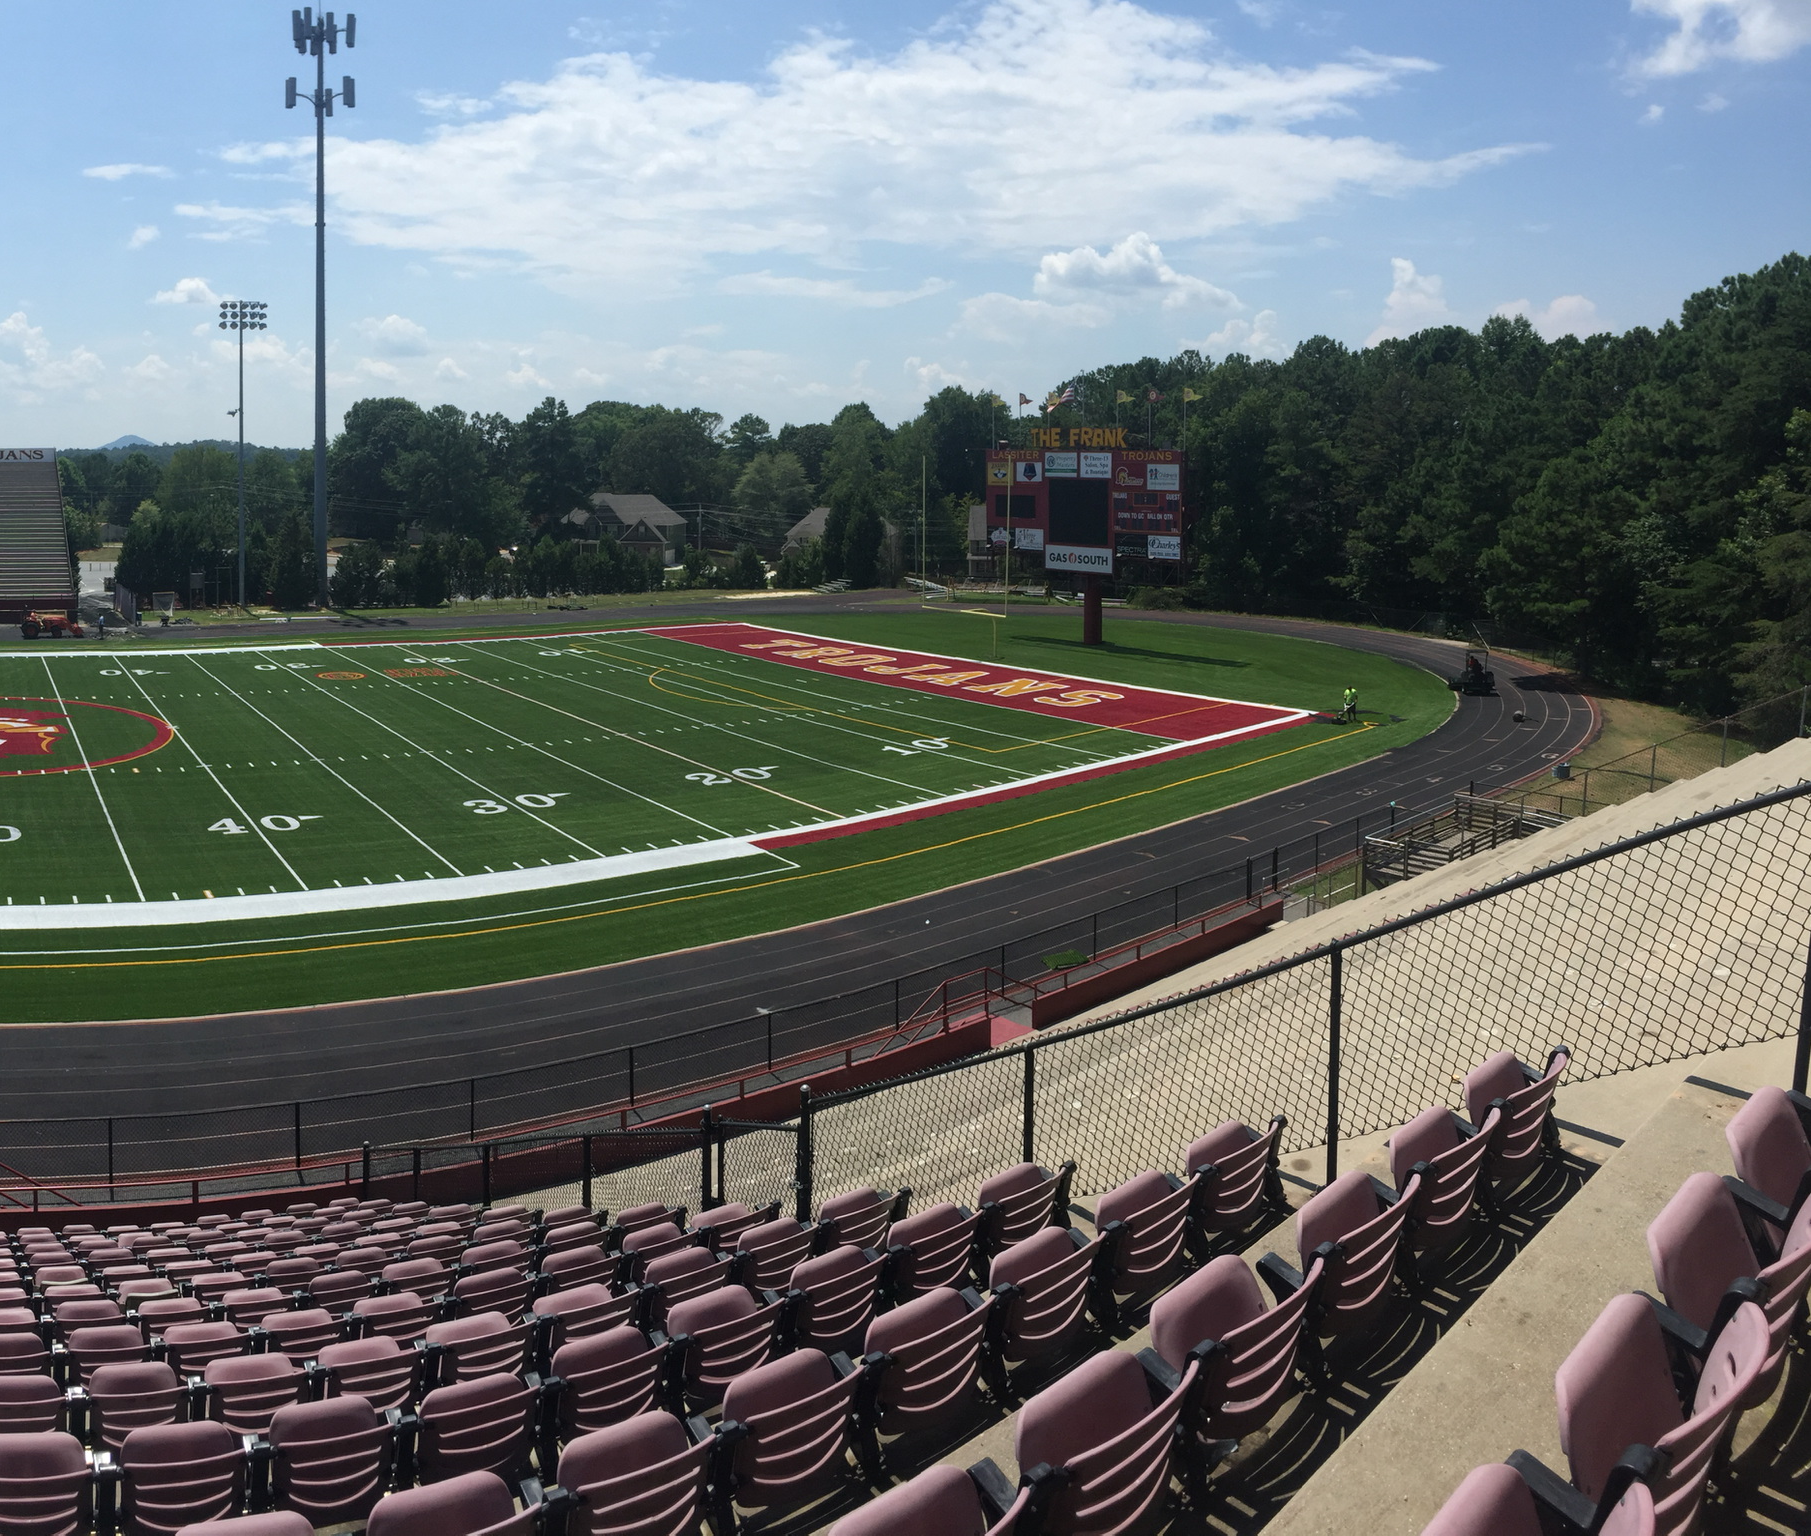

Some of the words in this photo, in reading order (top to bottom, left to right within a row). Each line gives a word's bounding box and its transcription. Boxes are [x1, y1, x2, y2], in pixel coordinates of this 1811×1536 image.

[1031, 428, 1060, 448] THE
[1070, 427, 1128, 448] FRANK
[992, 451, 1039, 460] LASSITER
[1121, 451, 1172, 460] TROJANS
[1049, 552, 1068, 563] GAS
[1077, 554, 1108, 566] SOUTH
[739, 638, 1124, 707] TROJANS
[882, 738, 944, 756] 10
[685, 767, 772, 786] 20
[462, 793, 557, 815] 30
[207, 815, 300, 835] 40
